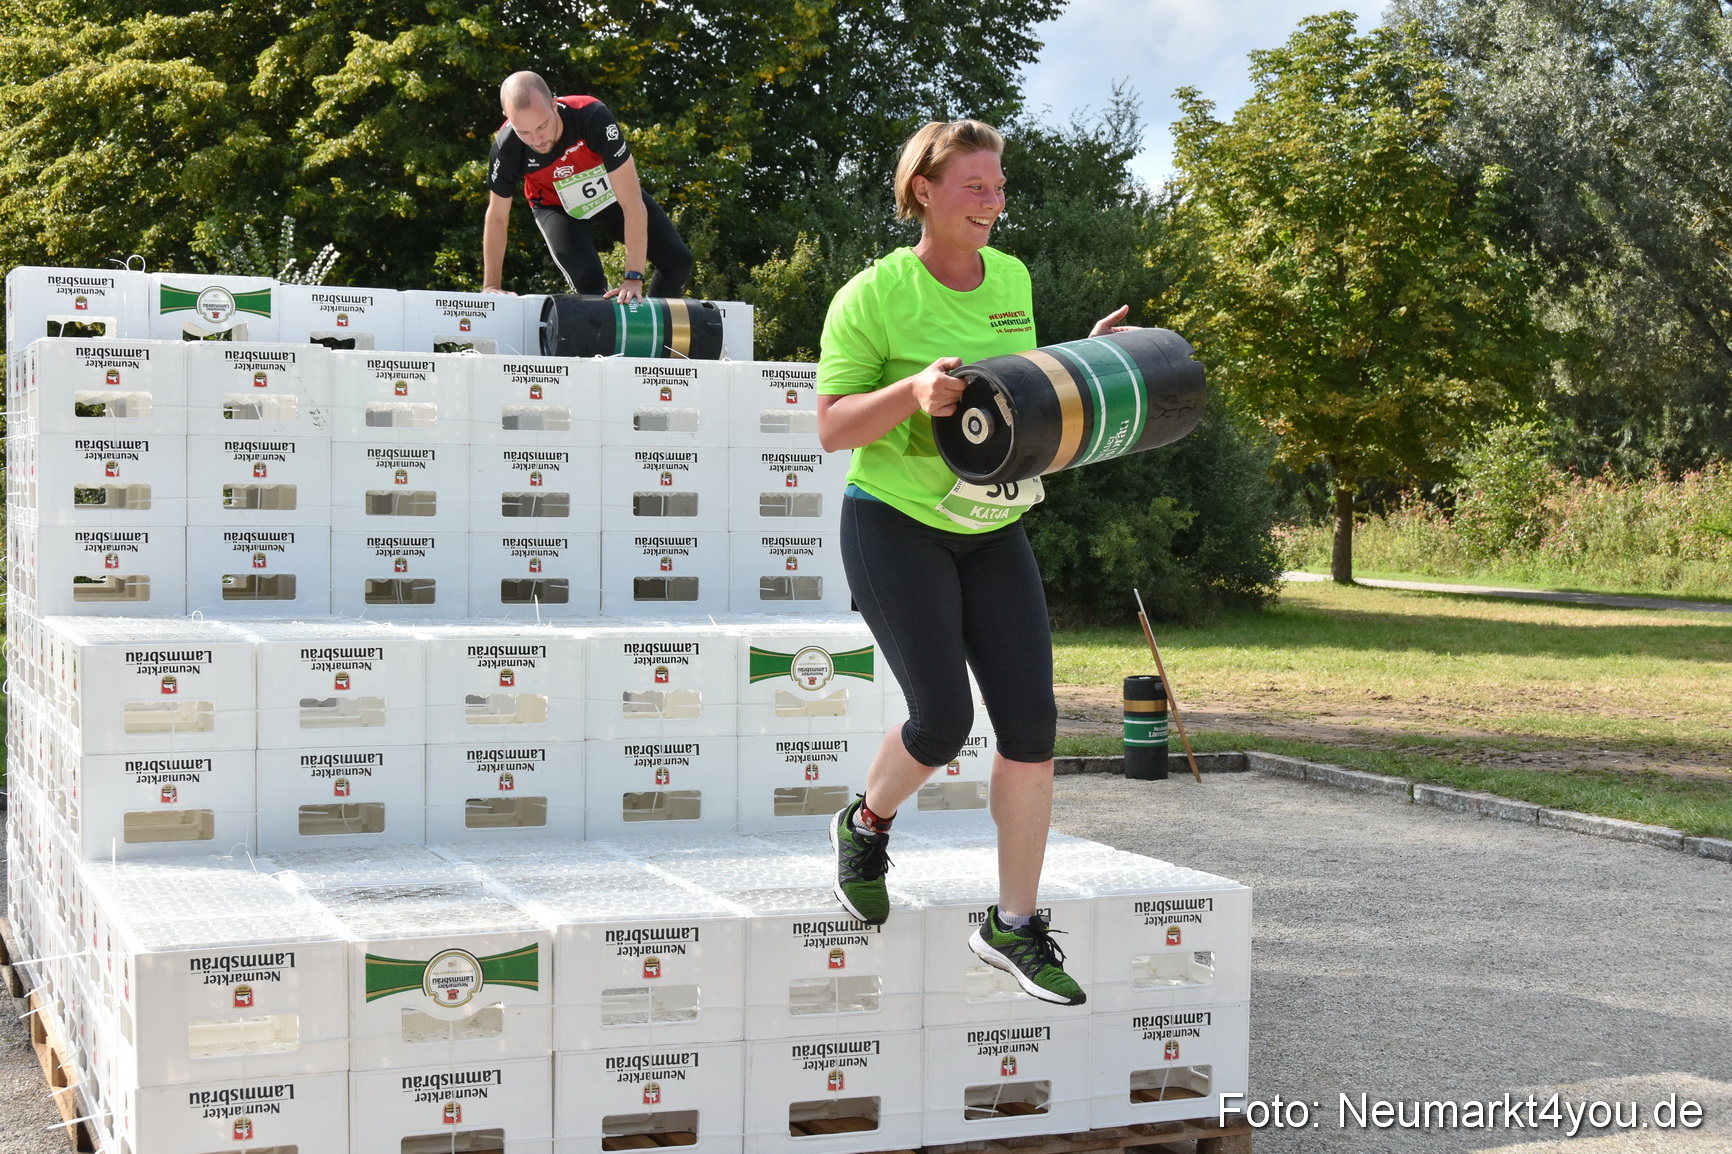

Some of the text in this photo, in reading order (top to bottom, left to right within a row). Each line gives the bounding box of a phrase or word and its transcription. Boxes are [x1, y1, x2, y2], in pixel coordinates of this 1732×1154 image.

[582, 177, 608, 198] 61
[48, 276, 114, 288] Lammsbräu
[56, 287, 105, 296] Neumarkter
[312, 294, 373, 306] Lammsbräu
[435, 299, 495, 312] Lammsbräu
[320, 305, 365, 314] Neumarkter
[443, 310, 487, 319] Neumarkter
[76, 347, 150, 360] Lammsbräu
[225, 350, 296, 363] Lammsbräu
[85, 360, 139, 369] Neumarkter
[234, 363, 286, 372] Neumarkter
[367, 360, 435, 373] Lammsbräu
[503, 364, 569, 377] Lammsbräu
[376, 372, 426, 381] Neumarkter
[634, 366, 698, 379] Lammsbräu
[762, 369, 817, 381] ammsbräu
[512, 376, 560, 385] Neumarkter
[643, 378, 689, 387] Neumarkter
[770, 381, 814, 390] Neumarkter
[75, 440, 149, 452] Lammsbräu
[224, 441, 295, 453] Lammsbräu
[84, 452, 139, 461] Neumarkter
[234, 453, 285, 462] Neumarkter
[367, 448, 435, 461] Lammsbräu
[503, 451, 569, 463] Lammsbräu
[635, 451, 698, 463] Lammsbräu
[761, 453, 822, 465] Lammsbräu
[376, 460, 426, 469] Neumarkter
[512, 463, 560, 471] Neumarkter
[643, 463, 689, 471] Neumarkter
[769, 465, 814, 473] Neumarkter
[969, 506, 1010, 519] KATJA
[75, 532, 149, 544] Lammsbräu
[224, 532, 295, 544] Lammsbräu
[367, 537, 435, 549] Lammsbräu
[502, 538, 568, 549] Lammsbräu
[635, 537, 698, 548] Lammsbräu
[762, 537, 822, 548] Lammsbräu
[84, 544, 138, 553] Neumarkter
[233, 544, 285, 553] Neumarkter
[375, 549, 425, 558] Neumarkter
[511, 550, 559, 558] Neumarkter
[643, 548, 689, 556] Neumarkter
[769, 548, 814, 556] Neumarkter
[301, 647, 383, 662] Lammsbräu
[468, 645, 546, 659] Lammsbräu
[624, 643, 699, 656] Lammsbräu
[125, 650, 212, 665] Lammsbräu
[477, 659, 535, 669] Neumarkter
[633, 656, 689, 666] Neumarkter
[136, 665, 200, 676] Neumarkter
[311, 659, 372, 672] Neumarkter
[624, 743, 700, 757] Lammsbräu
[776, 740, 848, 754] Lammsbräu
[300, 753, 383, 768] Lammsbräu
[467, 749, 545, 763] Lammsbräu
[634, 755, 689, 768] Neumarkter
[785, 751, 838, 764] Neumarkter
[125, 758, 212, 774] Lammsbräu
[311, 765, 372, 779] Neumarkter
[477, 763, 535, 773] Neumarkter
[136, 771, 200, 785] Neumarkter
[1134, 898, 1213, 915] Lammsbräu
[1144, 913, 1202, 927] Neumarkter
[605, 927, 699, 946] Lammsbräu
[803, 934, 869, 949] Neumarkter
[617, 942, 686, 958] Neumarkter
[190, 952, 295, 972] Lammsbräu
[203, 970, 281, 986] Neumarkter
[432, 976, 474, 985] Lammsbräu
[1133, 1012, 1211, 1030] Lammsbräu
[967, 1026, 1050, 1046] Lammsbräu
[1142, 1027, 1200, 1041] Neumarkter
[792, 1040, 880, 1059] Lammsbräu
[977, 1042, 1039, 1056] Neumarkter
[606, 1052, 699, 1071] Lammsbräu
[803, 1056, 868, 1071] Neumarkter
[402, 1069, 502, 1090] Lammsbräu
[617, 1069, 686, 1084] Neumarkter
[189, 1084, 294, 1106] Lammsbräu
[414, 1087, 488, 1103] Neumarkter
[202, 1102, 280, 1119] Neumarkter
